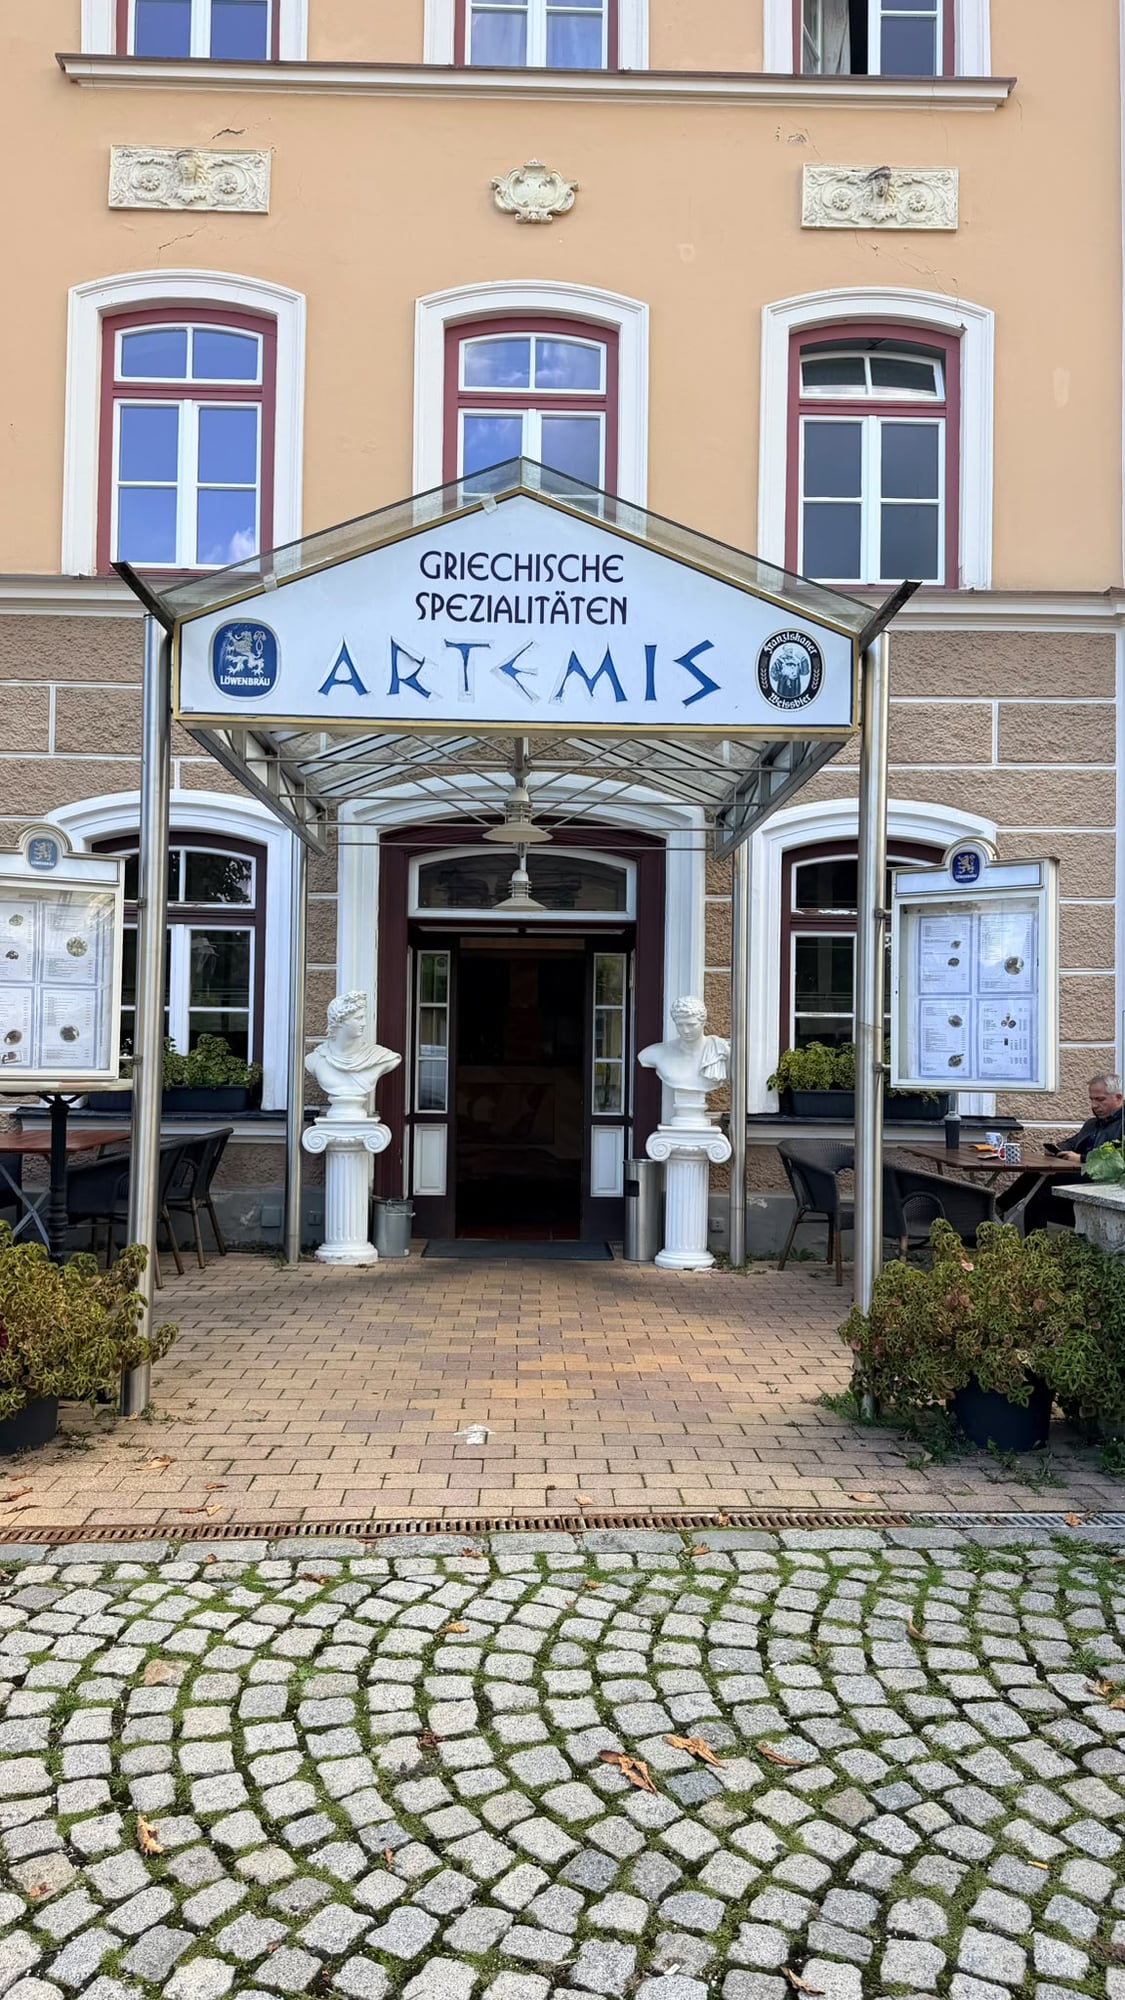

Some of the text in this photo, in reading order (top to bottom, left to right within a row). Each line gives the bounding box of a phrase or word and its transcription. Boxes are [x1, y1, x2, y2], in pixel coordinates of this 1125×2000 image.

[419, 550, 624, 583] GRIECHISCHE
[415, 590, 628, 625] SPEZIALITÄTEN
[763, 631, 818, 655] Franziskaner
[220, 675, 270, 686] LÖWENBRÄU
[317, 635, 722, 708] ARTEMIS
[768, 692, 811, 709] Weissbier
